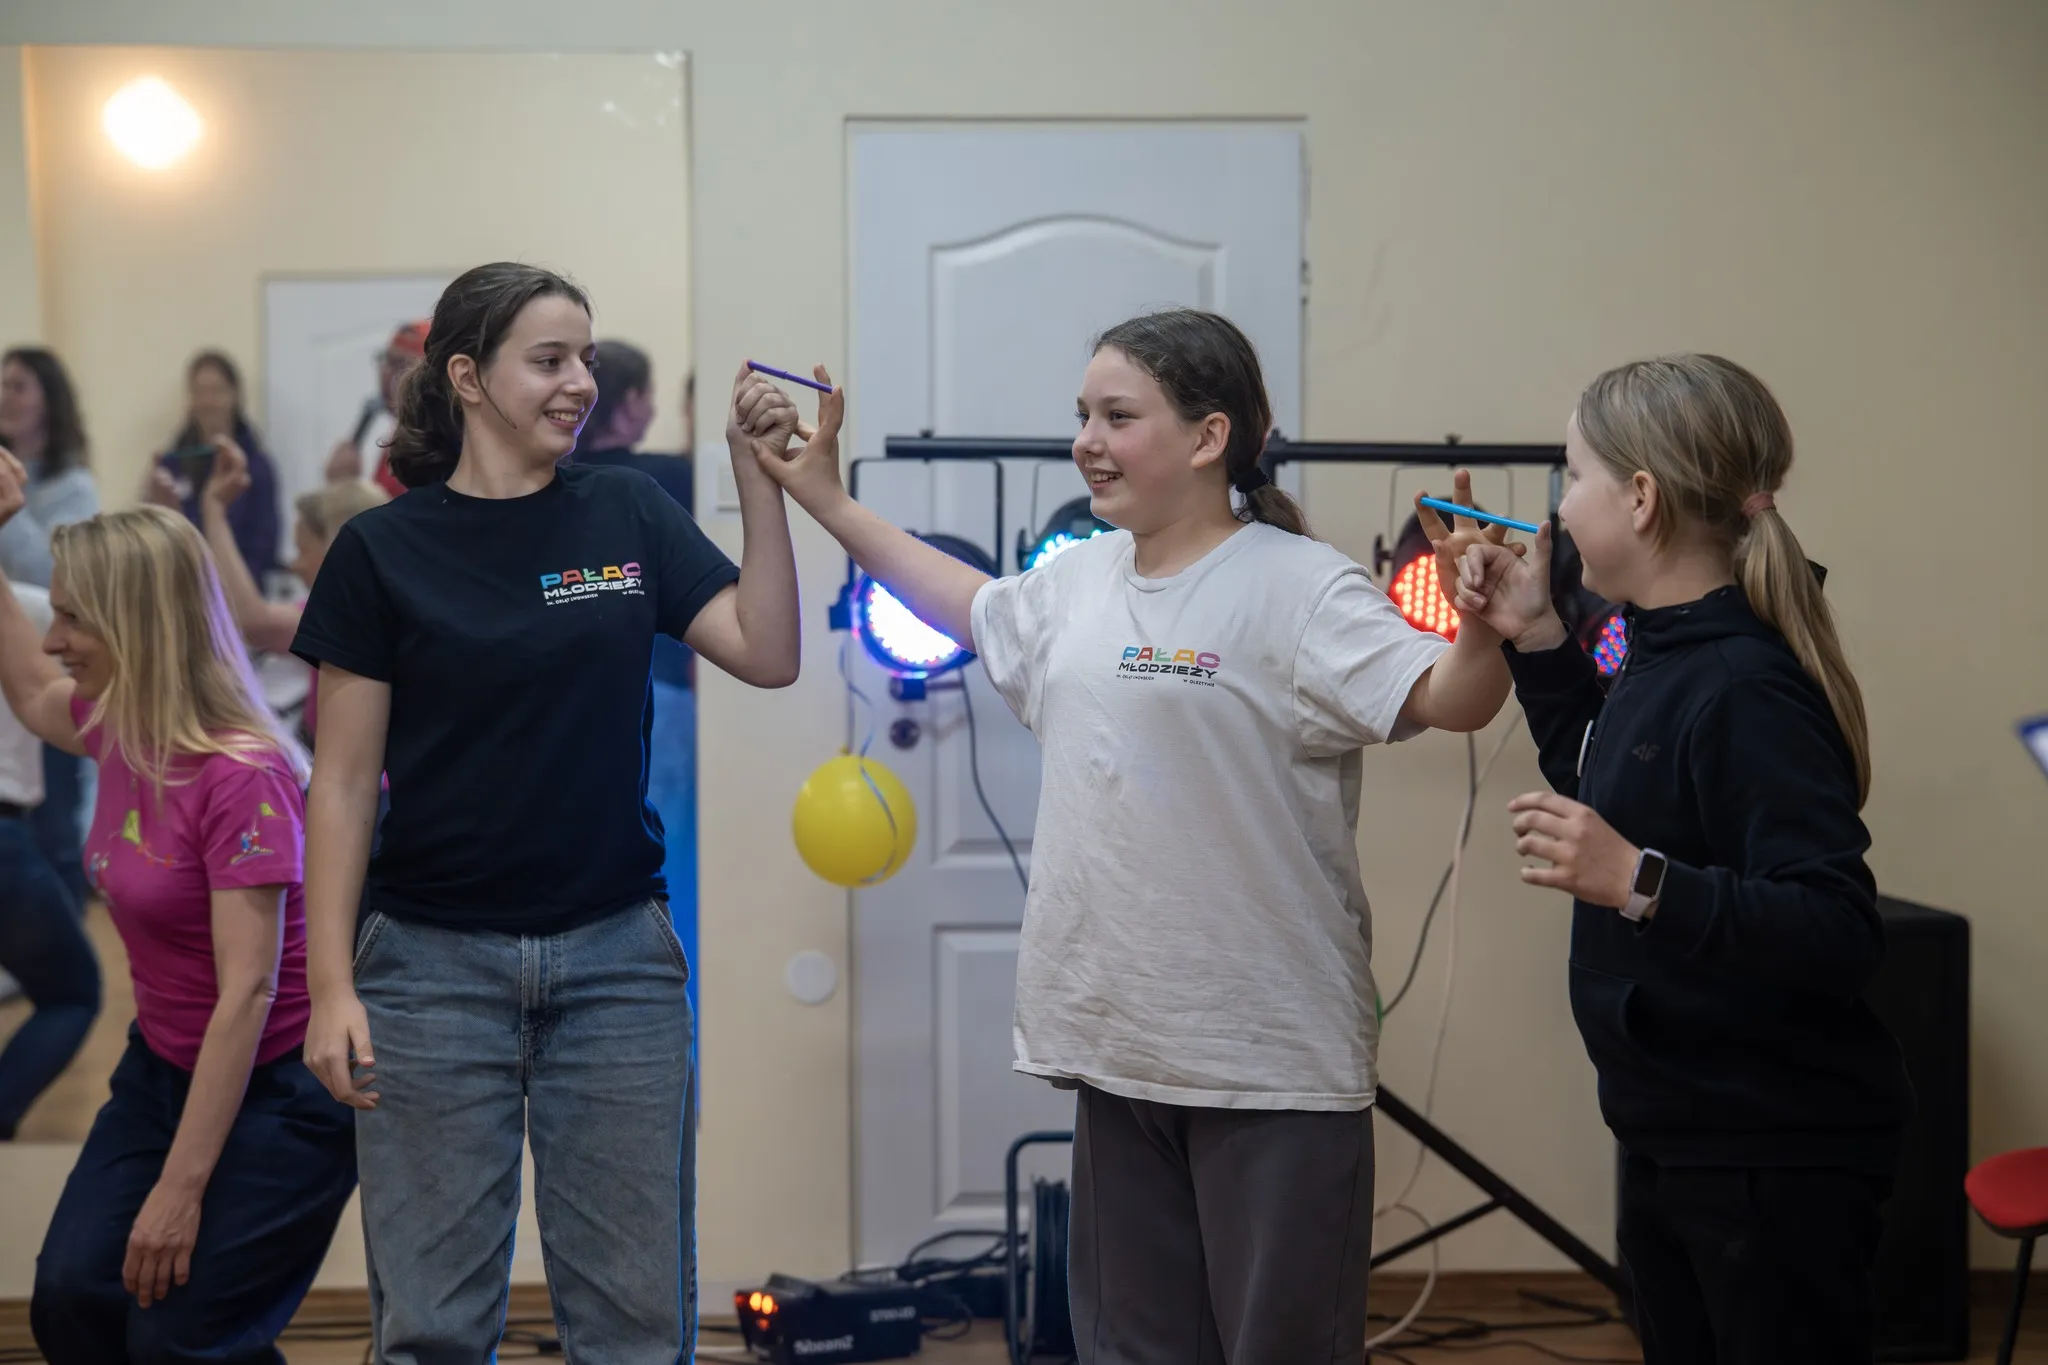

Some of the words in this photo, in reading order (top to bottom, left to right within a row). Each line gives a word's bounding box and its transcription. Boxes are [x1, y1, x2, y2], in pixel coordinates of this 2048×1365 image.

[540, 562, 641, 589] PAŁAC
[543, 577, 642, 600] MŁODZIEŻY
[1122, 646, 1221, 669] PAŁAC
[1118, 662, 1218, 679] MŁODZIEŻY
